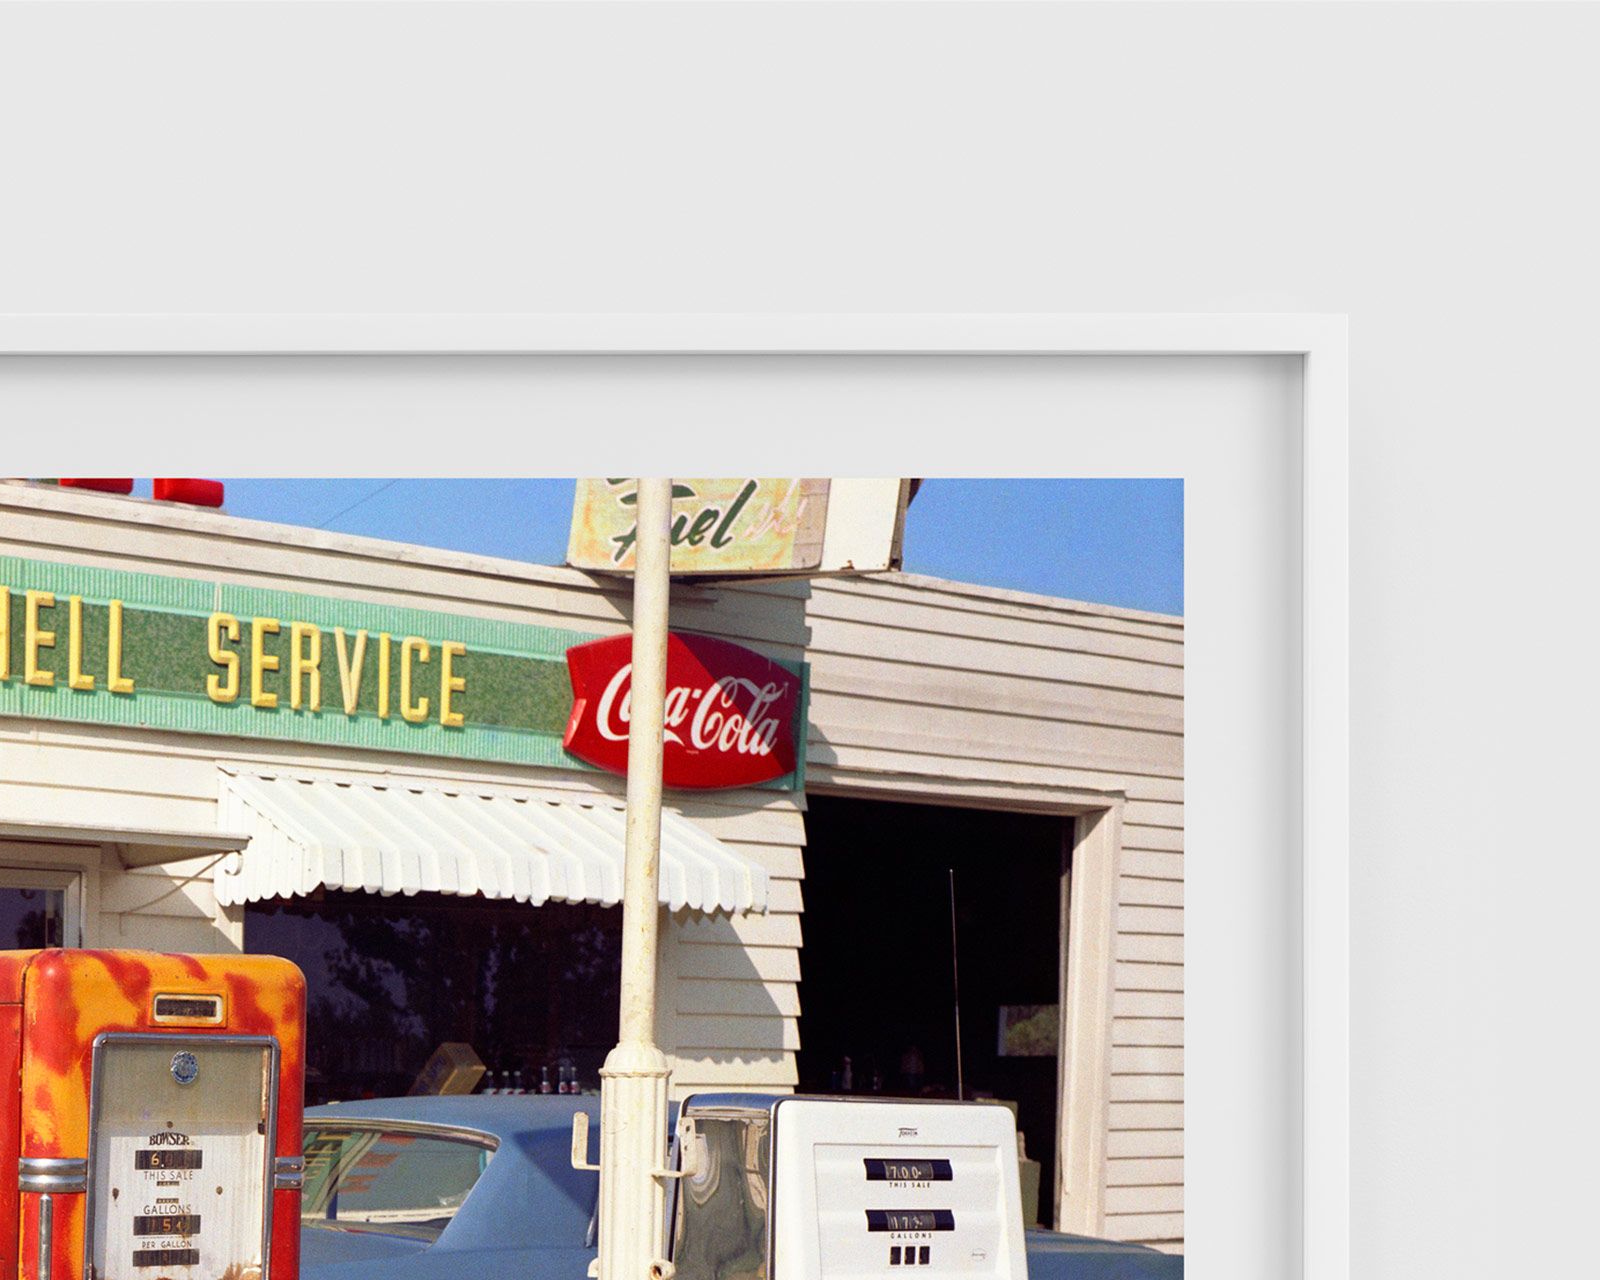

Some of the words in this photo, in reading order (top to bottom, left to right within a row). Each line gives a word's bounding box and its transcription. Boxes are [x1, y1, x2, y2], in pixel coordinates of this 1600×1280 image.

[206, 611, 467, 728] SERVICE
[149, 1132, 190, 1146] BOWSER
[144, 1170, 166, 1181] THIS
[170, 1170, 193, 1181] SALE
[143, 1204, 192, 1215] GALLONS
[160, 1240, 192, 1248] GALLON
